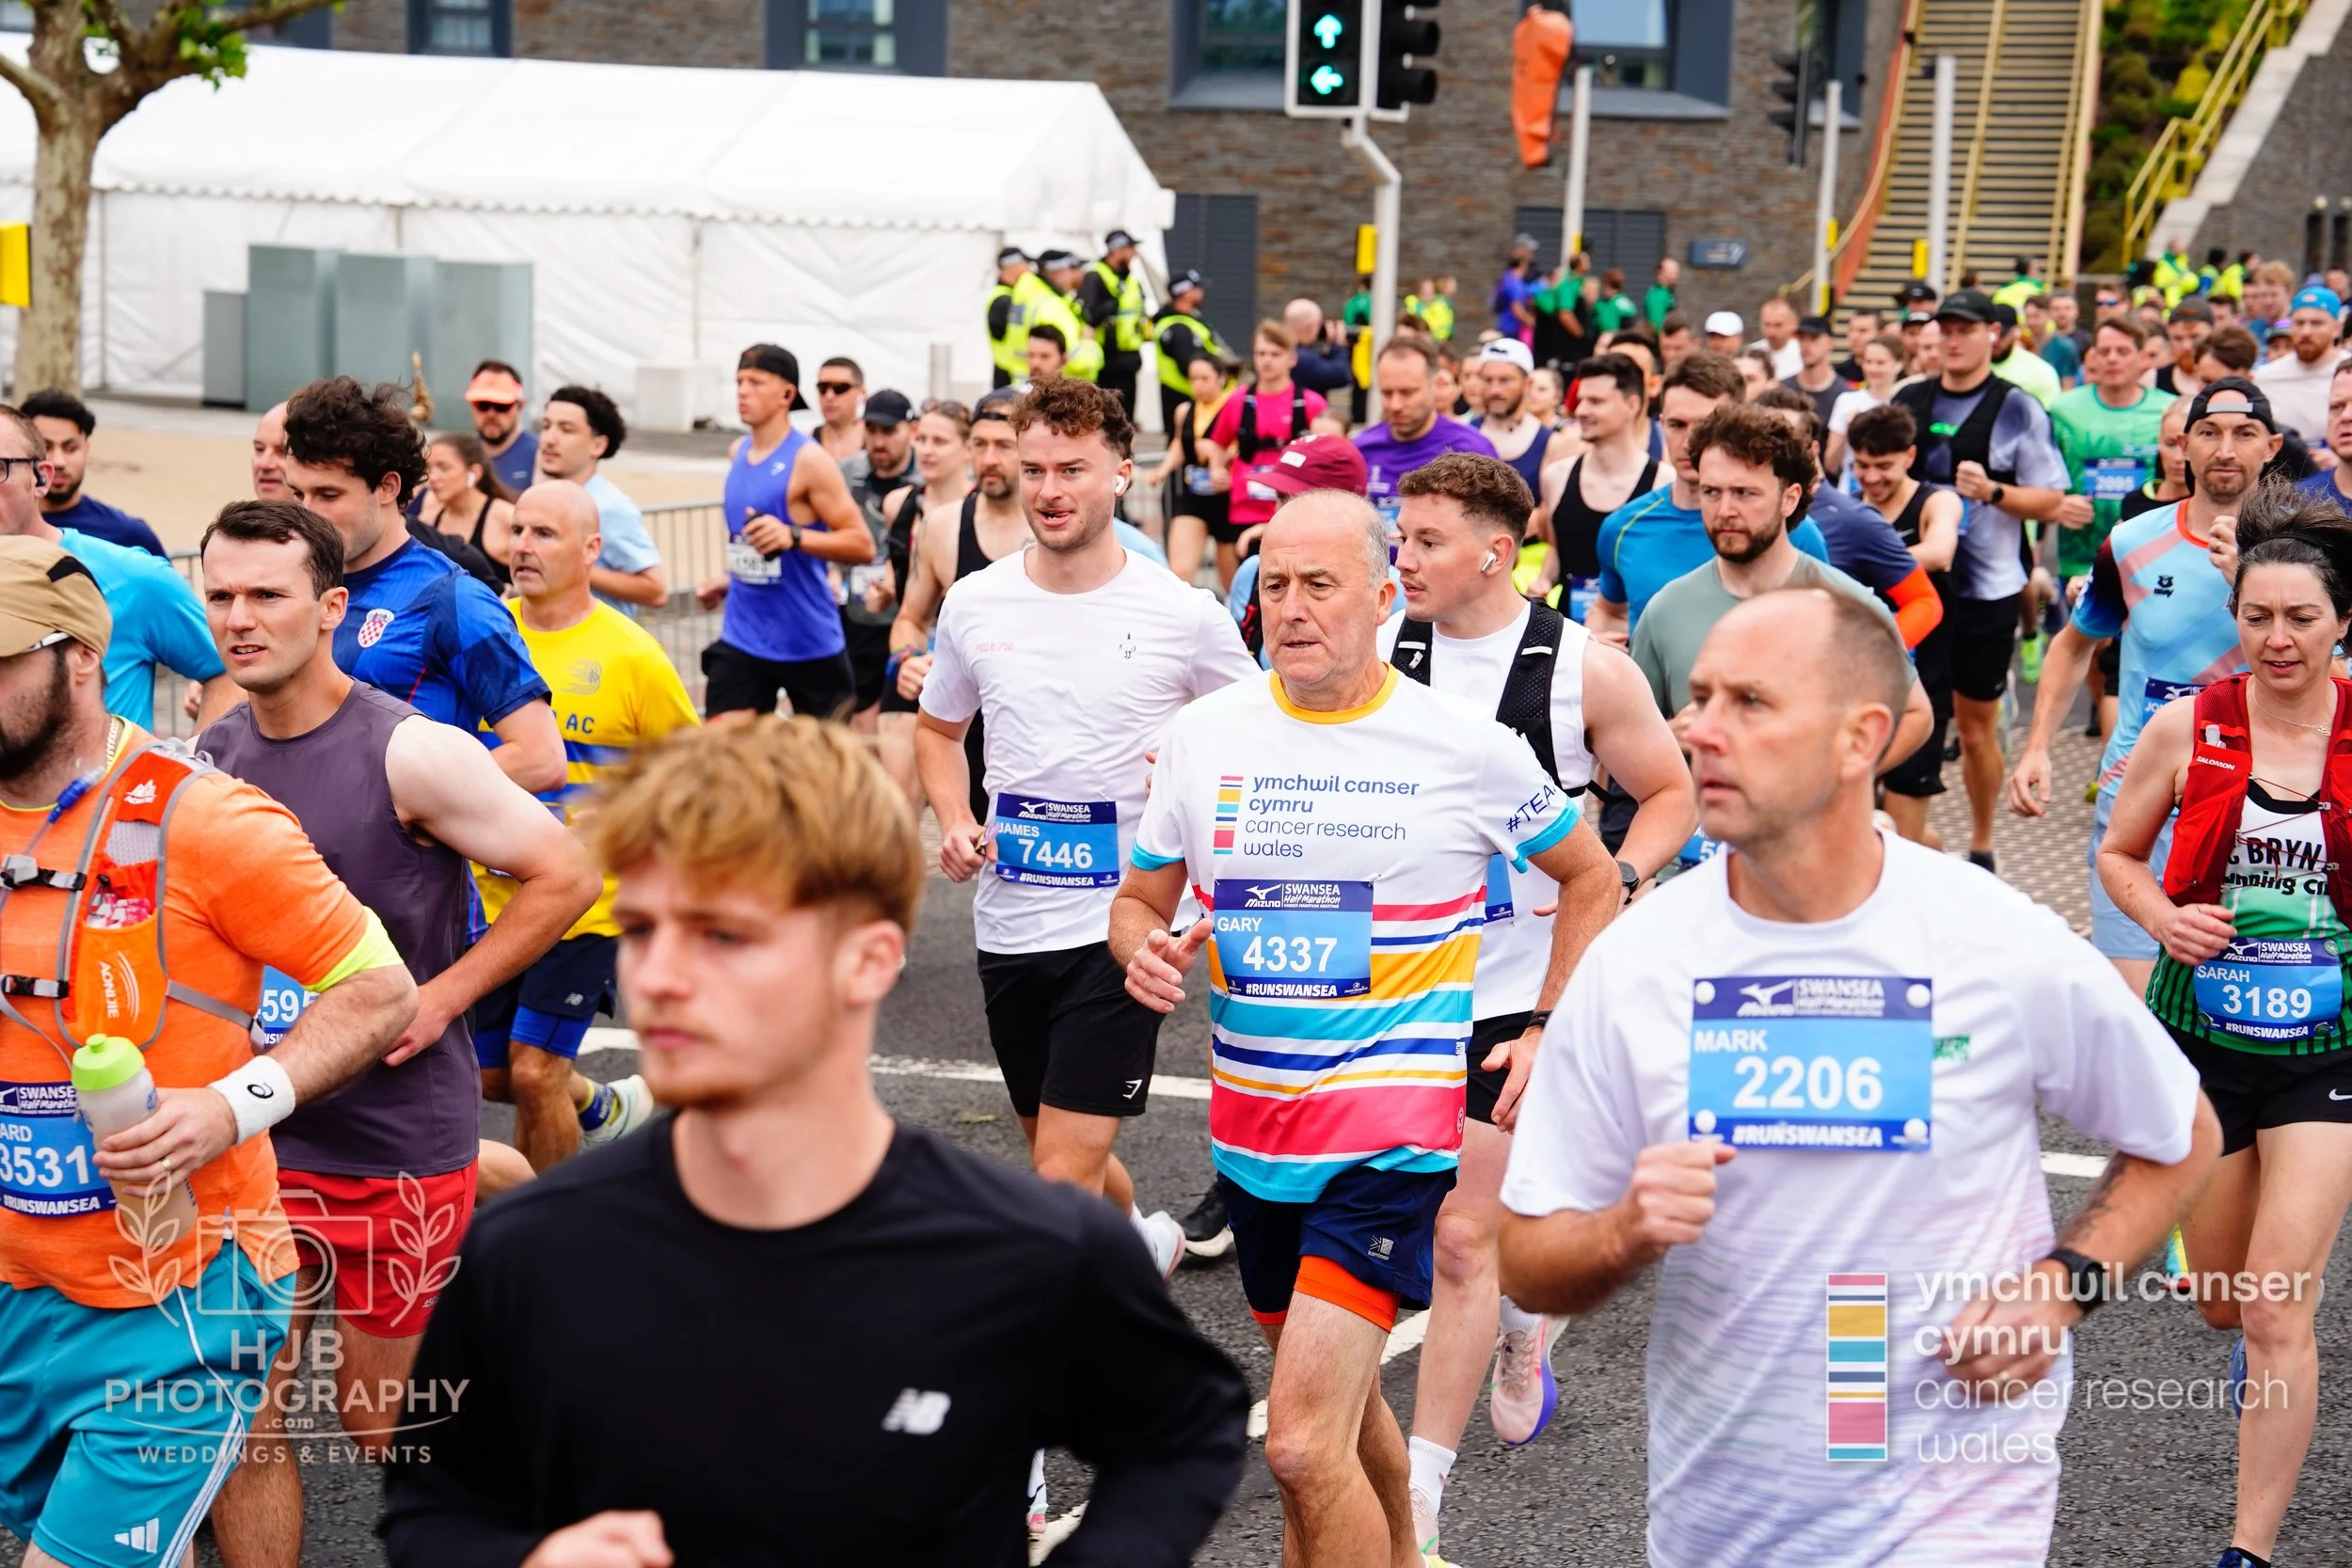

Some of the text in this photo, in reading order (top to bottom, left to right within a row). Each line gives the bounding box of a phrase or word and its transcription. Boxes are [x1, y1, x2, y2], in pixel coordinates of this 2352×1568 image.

[565, 712, 595, 734] AC
[2196, 755, 2235, 770] SALOMON
[1253, 774, 1420, 796] ymchwil canser
[1047, 802, 1091, 814] SWANSEA
[1248, 796, 1313, 815] cymru
[1505, 780, 1558, 833] #TEA
[997, 822, 1040, 837] JAMES
[1245, 817, 1406, 841] cancer research
[1018, 838, 1093, 869] 7446
[1244, 838, 1303, 858] wales
[2247, 837, 2323, 872] BRYN
[1019, 872, 1095, 886] #RUNSWANSEA
[1284, 883, 1341, 895] SWANSEA
[2223, 871, 2297, 895] unning
[1283, 895, 1341, 905] Half Marathon
[1216, 917, 1263, 932] GARY
[1242, 936, 1338, 973] 4337
[2260, 951, 2312, 960] Half Marathon
[2261, 942, 2312, 953] SWANSEA
[2197, 965, 2250, 983] SARAH
[99, 960, 120, 1019] AONIJIE
[1246, 983, 1338, 997] #RUNSWANSEA
[1799, 978, 1884, 998] SWANSEA
[2222, 984, 2312, 1019] 3189
[2225, 1022, 2309, 1038] #RUNSWANSEA
[1693, 1029, 1769, 1053] MARK
[20, 1085, 75, 1099] SWANSE
[1732, 1054, 1883, 1111] 2206
[1732, 1124, 1883, 1148] #RUNSWANSEA
[3, 1194, 101, 1215] #RUNSWANSEA
